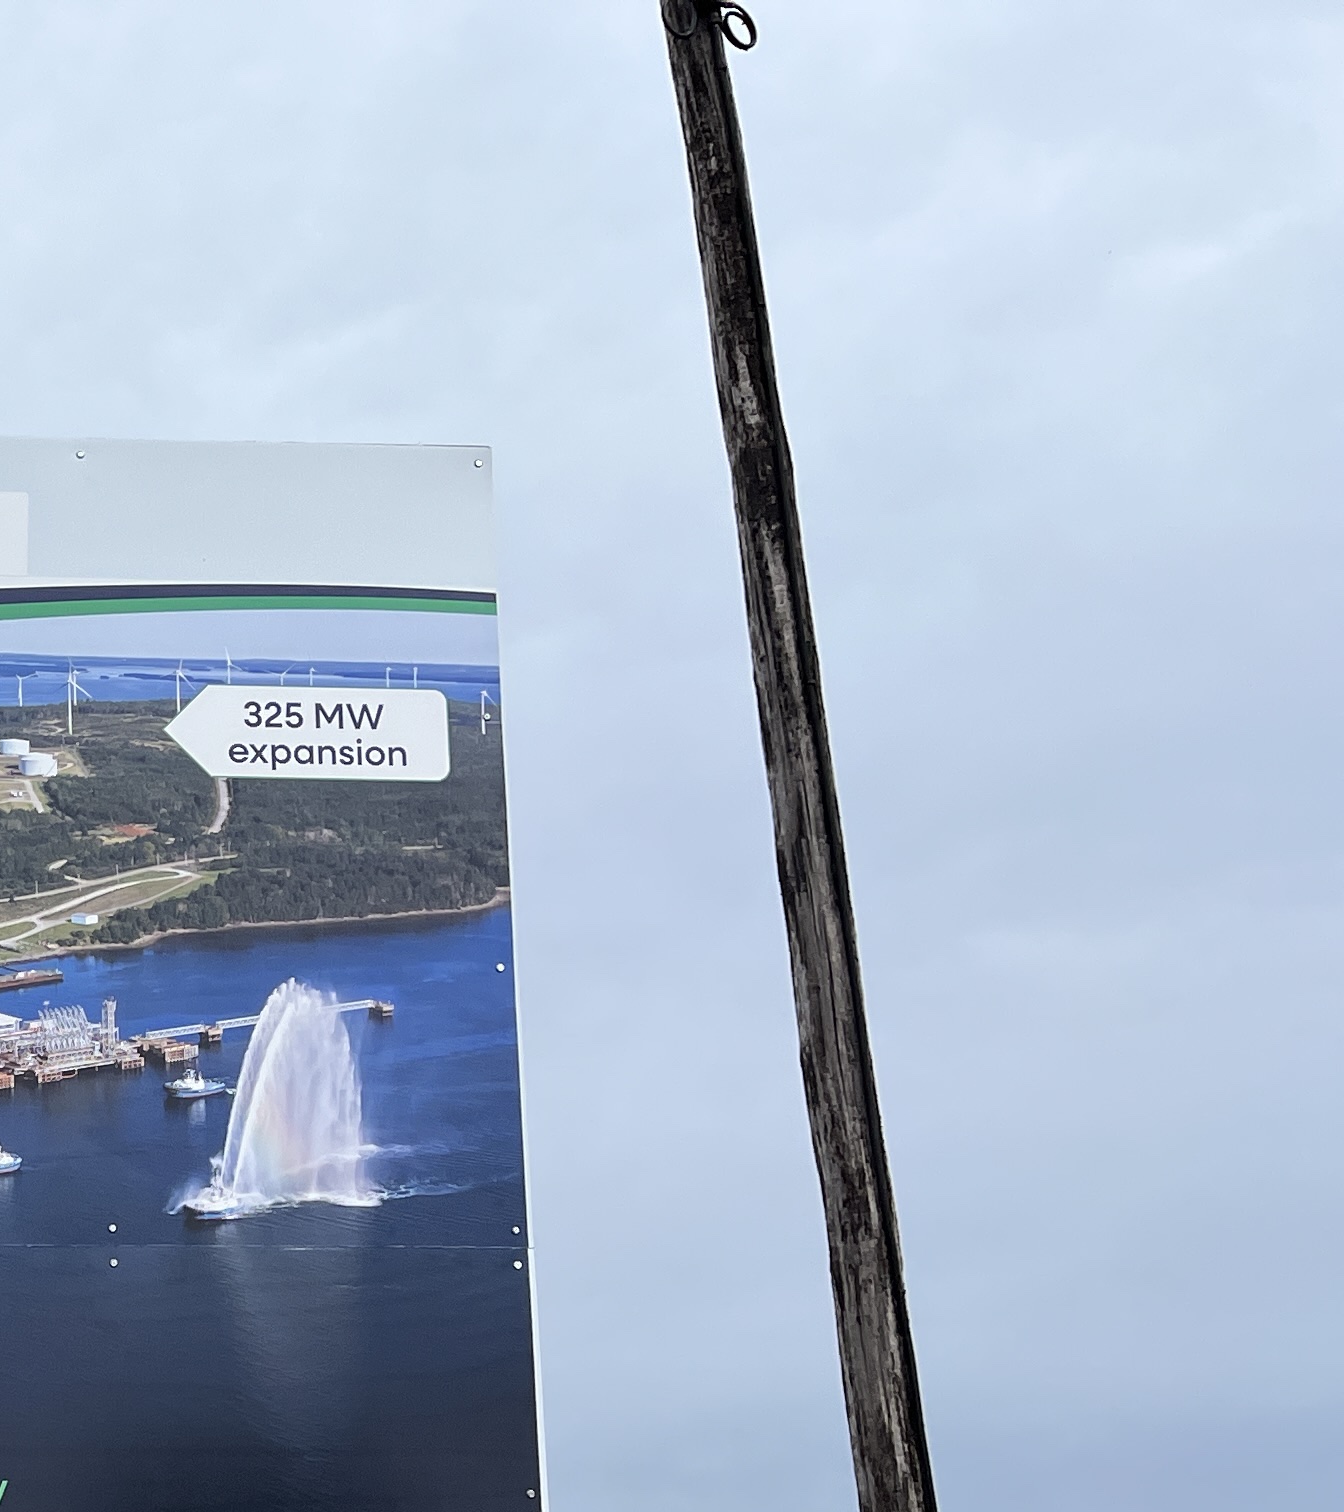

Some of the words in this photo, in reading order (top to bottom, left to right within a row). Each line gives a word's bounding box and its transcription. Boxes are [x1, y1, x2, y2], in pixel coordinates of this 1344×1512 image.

[244, 701, 304, 729] 325
[314, 702, 384, 730] MW
[228, 738, 408, 771] expansion
